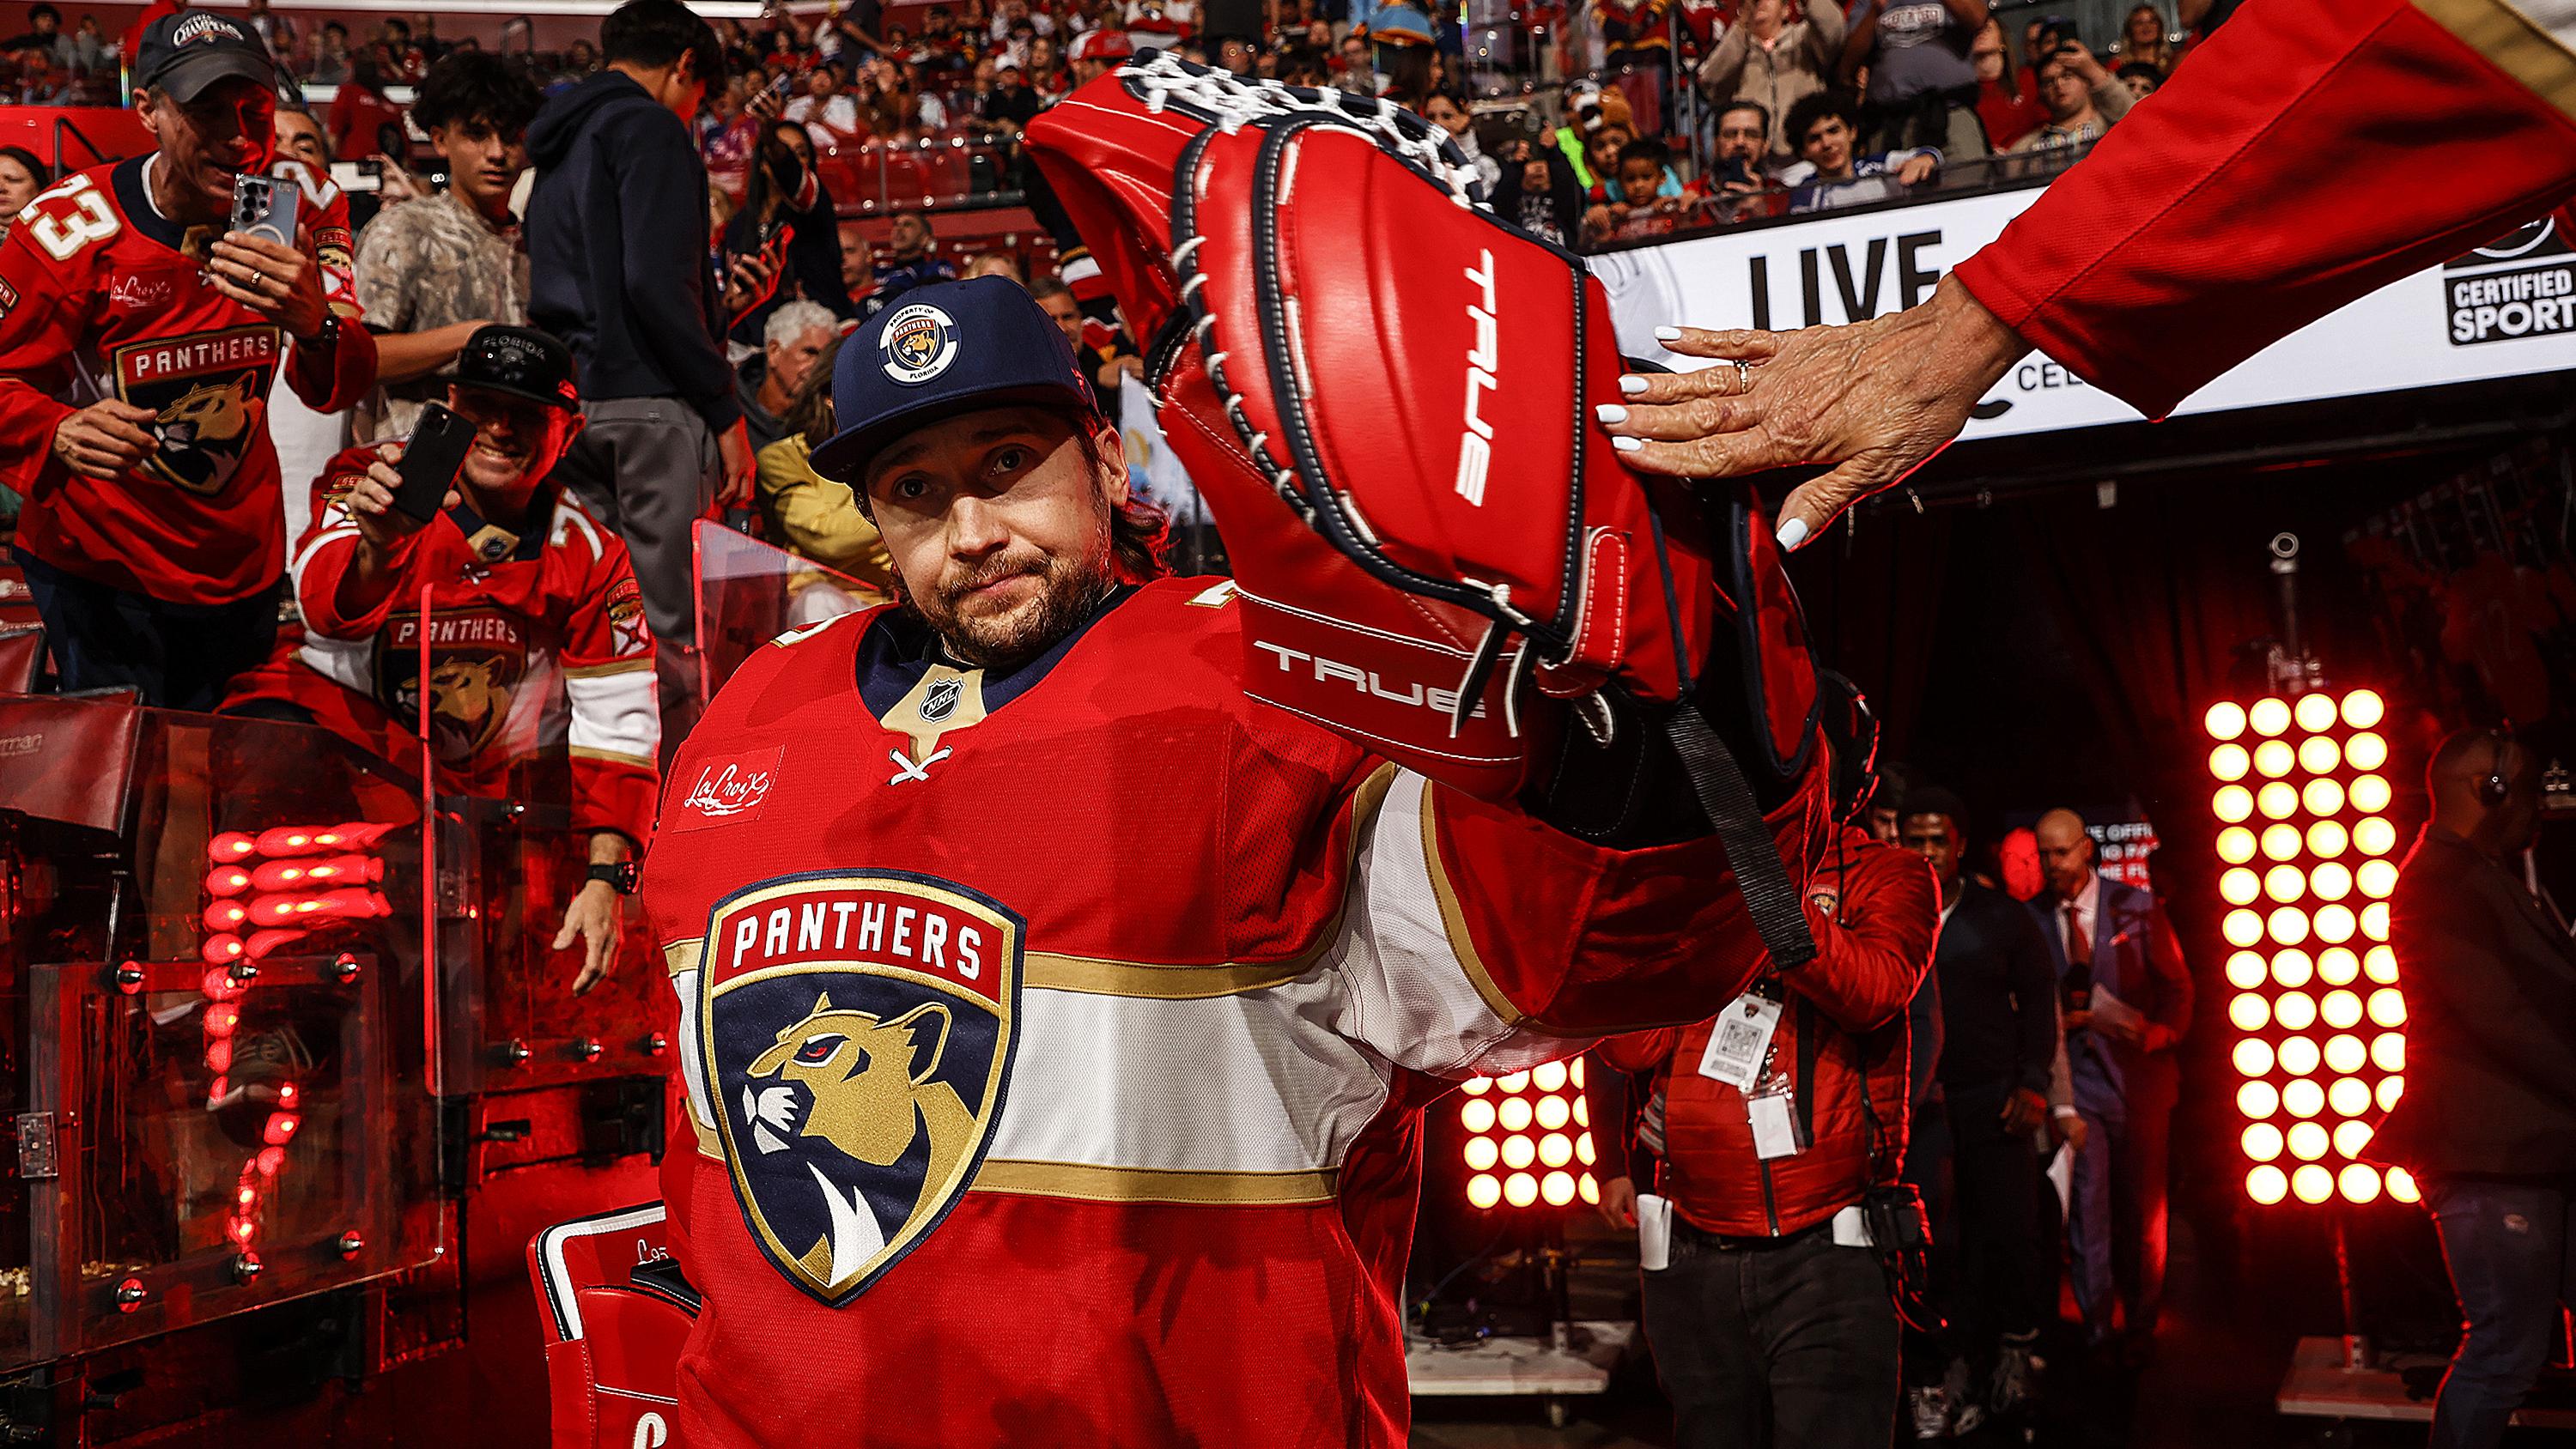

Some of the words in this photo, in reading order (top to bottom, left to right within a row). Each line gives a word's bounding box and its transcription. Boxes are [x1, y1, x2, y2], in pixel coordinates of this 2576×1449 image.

[17, 173, 122, 261] 23
[2453, 269, 2573, 308] CERTIFIED
[890, 306, 924, 327] PROPERTY
[894, 320, 933, 338] PANTHERS
[2452, 294, 2576, 342] SPORT
[135, 336, 269, 379] PANTHERS
[910, 366, 939, 379] FLORIDA
[1455, 248, 1498, 507] TRUE
[927, 690, 955, 713] NHL
[1254, 640, 1486, 718] TRUE
[684, 764, 769, 813] LaCroix
[732, 901, 981, 980] PANTHERS
